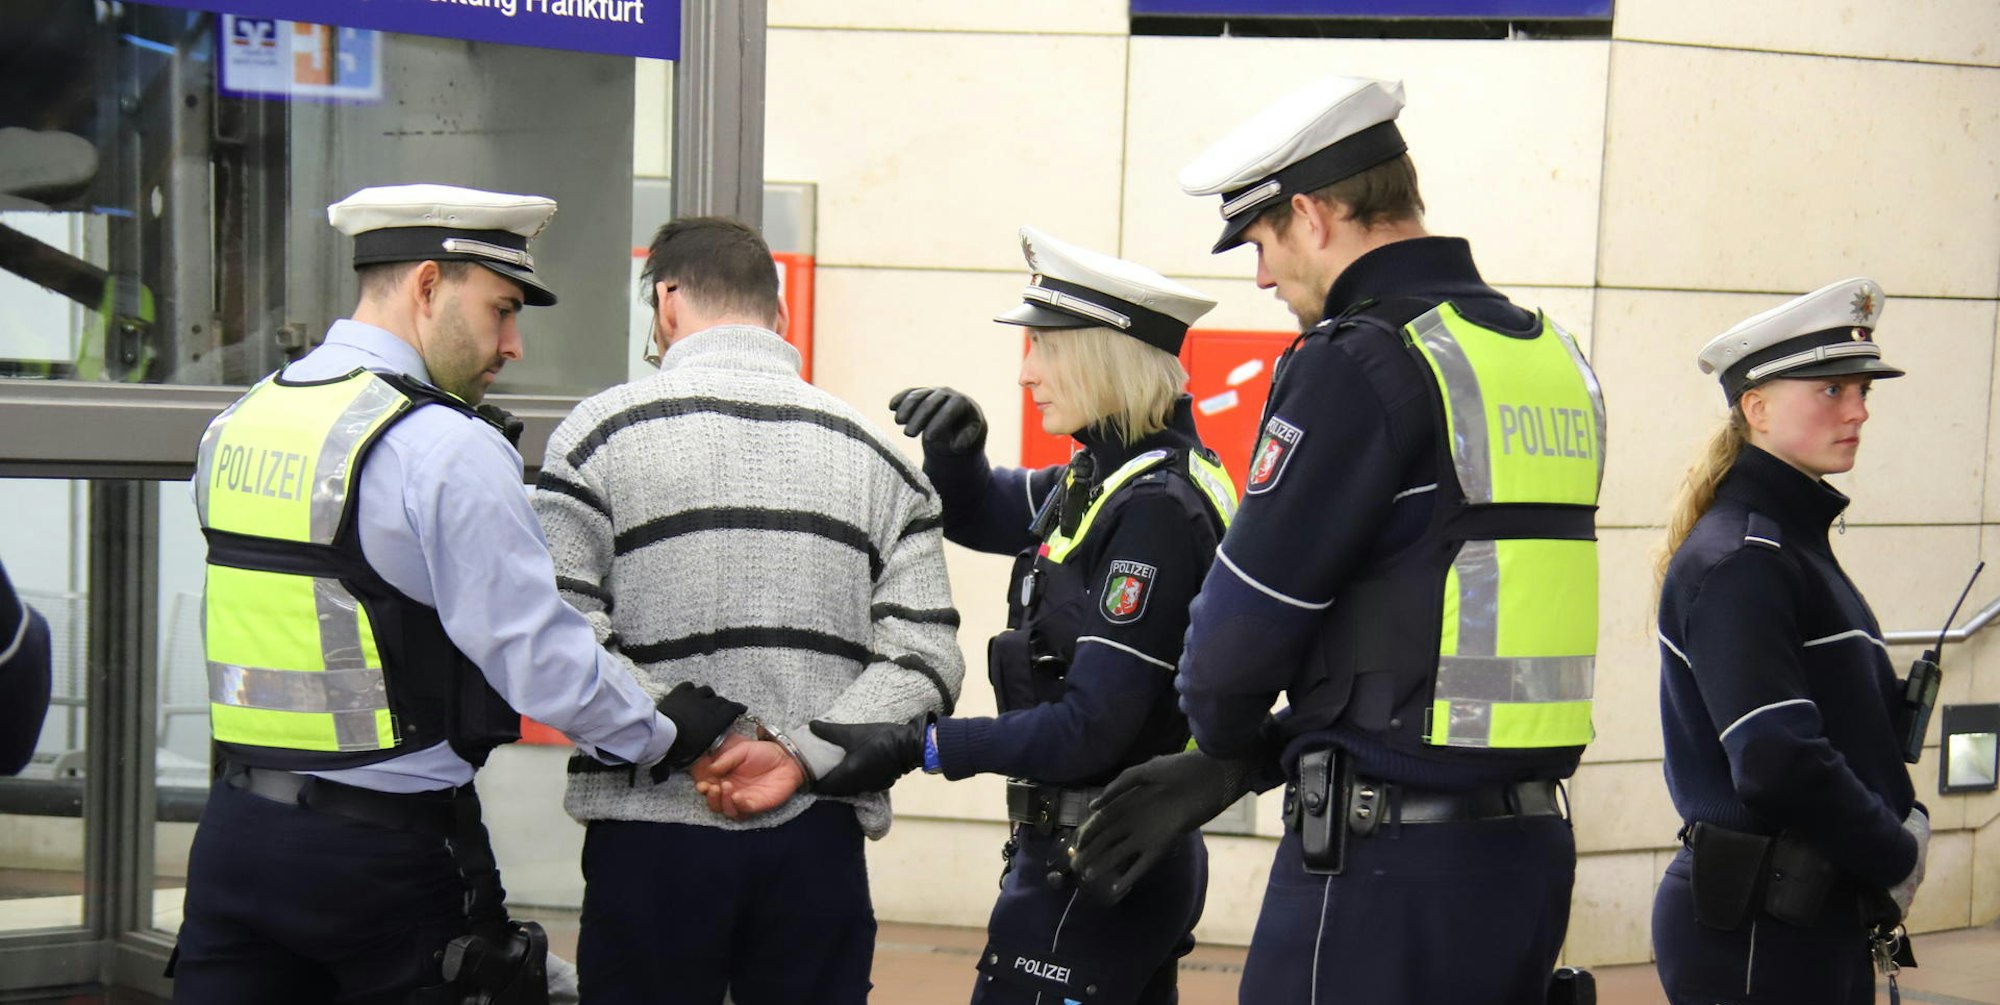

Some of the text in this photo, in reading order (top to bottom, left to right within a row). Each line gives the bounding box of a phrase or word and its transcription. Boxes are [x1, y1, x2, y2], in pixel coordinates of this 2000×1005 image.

[1498, 404, 1592, 460] POLIZEI
[216, 444, 308, 502] POLIZEI
[1113, 562, 1153, 578] POLIZEI
[1014, 956, 1071, 983] POLIZEI
